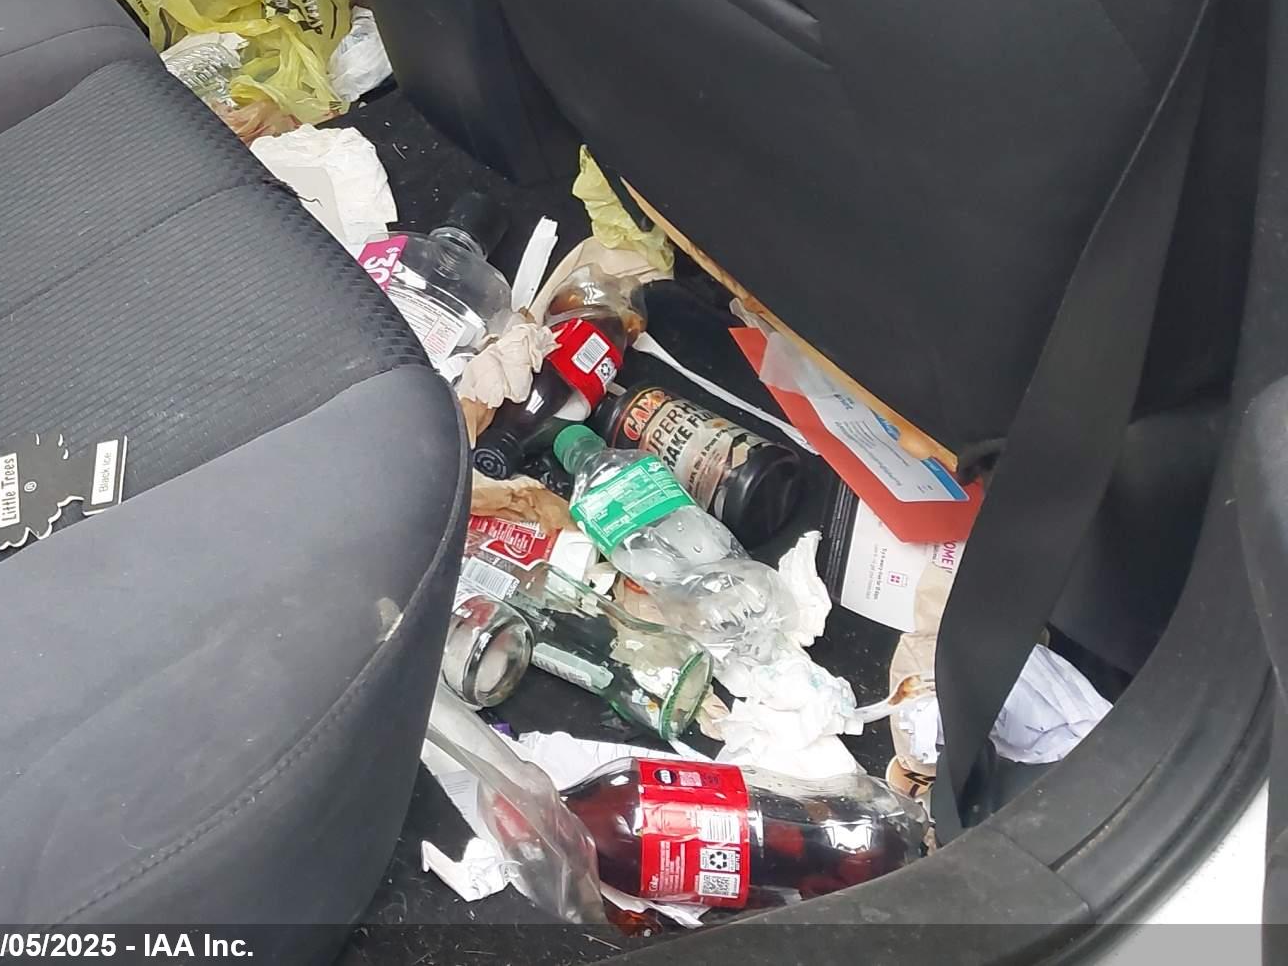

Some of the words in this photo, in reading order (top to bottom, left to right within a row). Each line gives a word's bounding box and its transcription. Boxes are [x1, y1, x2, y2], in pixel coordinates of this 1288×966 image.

[647, 409, 684, 456] UPER
[663, 425, 693, 472] RAKE
[1, 457, 17, 490] Trees
[98, 468, 110, 493] Black
[1, 491, 17, 522] Little
